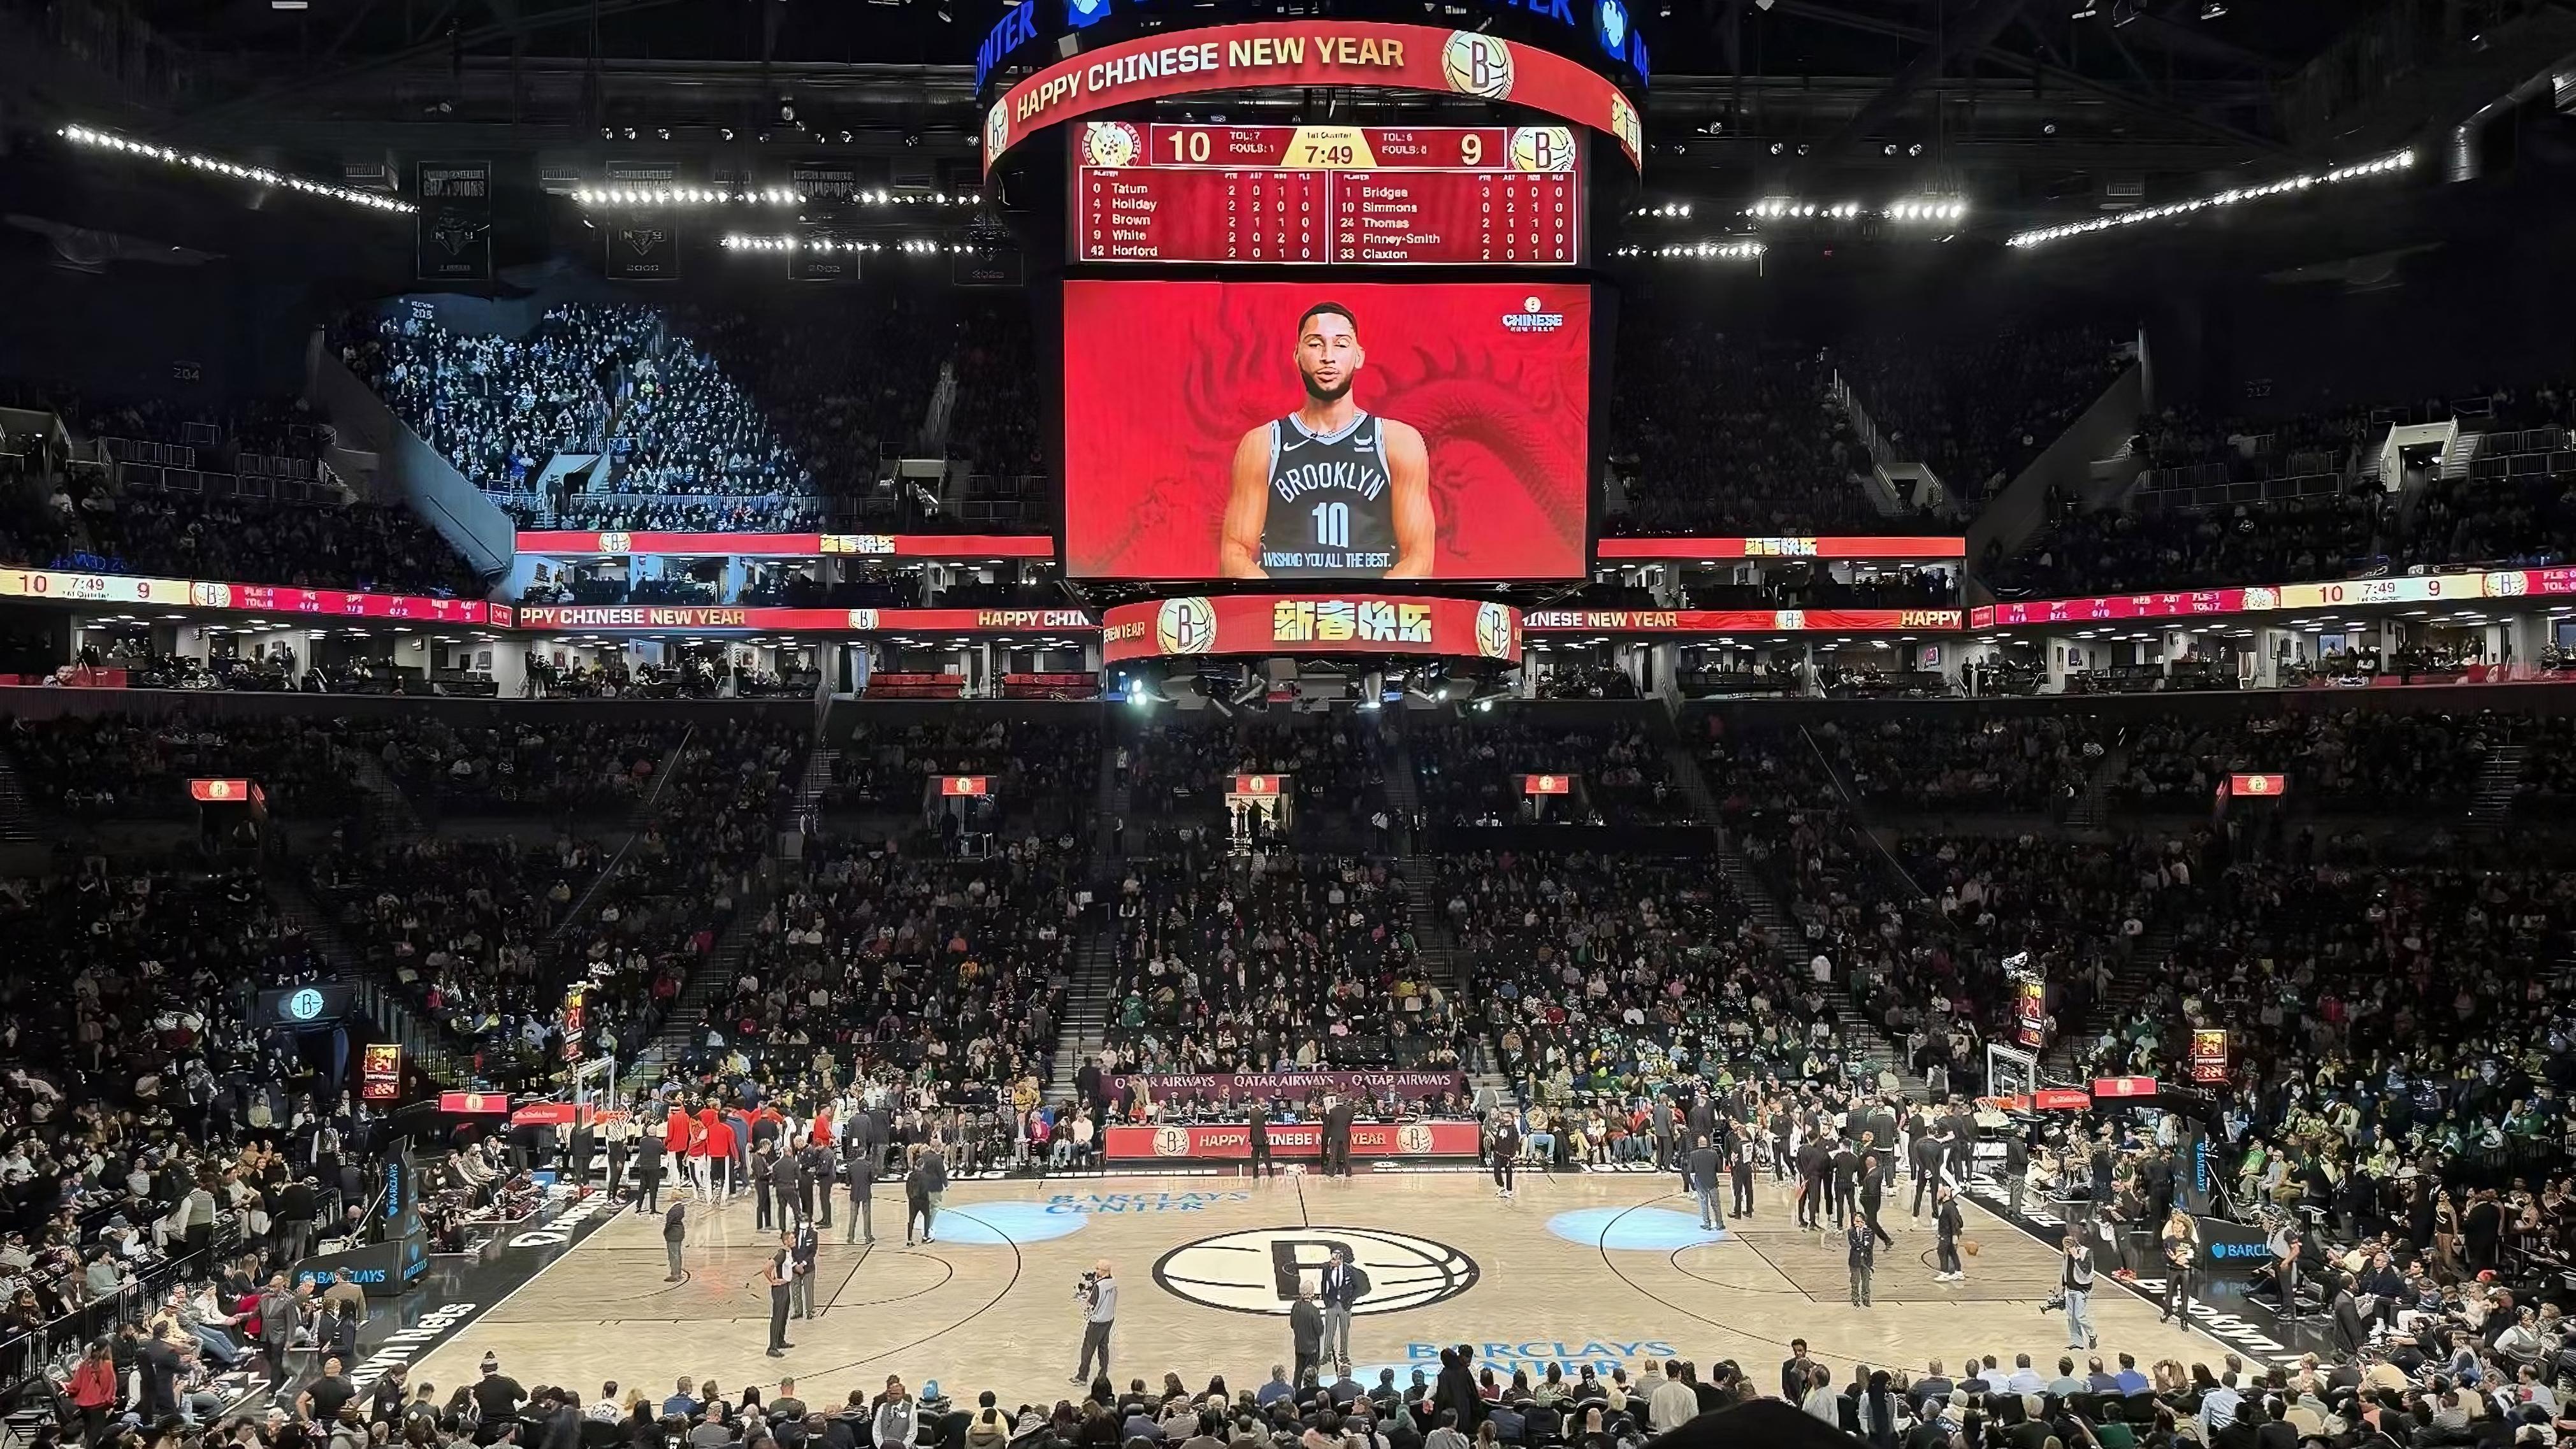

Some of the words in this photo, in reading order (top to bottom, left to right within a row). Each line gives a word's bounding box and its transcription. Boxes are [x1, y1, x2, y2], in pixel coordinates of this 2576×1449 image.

[1017, 70, 1082, 122] HAPPY
[1088, 43, 1219, 92] CHINESE
[1229, 37, 1305, 66] NEW
[1314, 37, 1404, 66] YEAR
[1169, 131, 1210, 161] 10
[1461, 134, 1482, 165] 9
[1305, 145, 1353, 164] 7:49
[1111, 184, 1147, 194] Tatum
[1363, 187, 1407, 199] Bridges
[1113, 198, 1157, 212] Holiday
[1363, 202, 1417, 212] Simmons
[1113, 214, 1150, 224] Brown
[1362, 218, 1409, 228] Thomas
[1113, 230, 1146, 240] White
[1364, 234, 1440, 246] Finney-Smith
[1113, 245, 1157, 256] Horford
[1363, 249, 1407, 259] Claxton
[1503, 314, 1563, 327] CHINESE
[1275, 462, 1385, 503] BROOKLYN
[1312, 502, 1349, 548] 10
[1263, 552, 1303, 567] WISHING
[1305, 553, 1324, 567] YOU
[1324, 553, 1343, 568] ALL
[1345, 553, 1364, 567] THE
[1365, 553, 1392, 568] BEST.
[19, 575, 47, 593] 10
[71, 578, 105, 591] 7:49
[137, 582, 150, 598] 9
[2319, 586, 2342, 602] 10
[2363, 582, 2395, 594] 7:49
[2428, 580, 2440, 596] 9
[560, 609, 644, 624] CHINESE
[649, 609, 692, 624] NEW
[696, 609, 745, 624] YEAR
[978, 611, 1038, 627] HAPPY
[1274, 601, 1432, 642] 新春快乐
[1588, 612, 1627, 626] NEW
[1632, 612, 1677, 626] YEAR
[1900, 611, 1962, 627] HAPPY
[1161, 1076, 1215, 1087] AIRWAYS
[1234, 1076, 1277, 1087] QATAR
[1278, 1075, 1334, 1086] AIRWAYS
[1397, 1074, 1451, 1086] AIRWAYS
[1199, 1134, 1246, 1146] HAPPY
[1269, 1133, 1312, 1146] INESE
[2228, 1244, 2270, 1257] BARCL
[317, 1270, 385, 1283] BACLAYS
[383, 1304, 476, 1343] Nets
[1406, 1341, 1676, 1358] BRCLAYS
